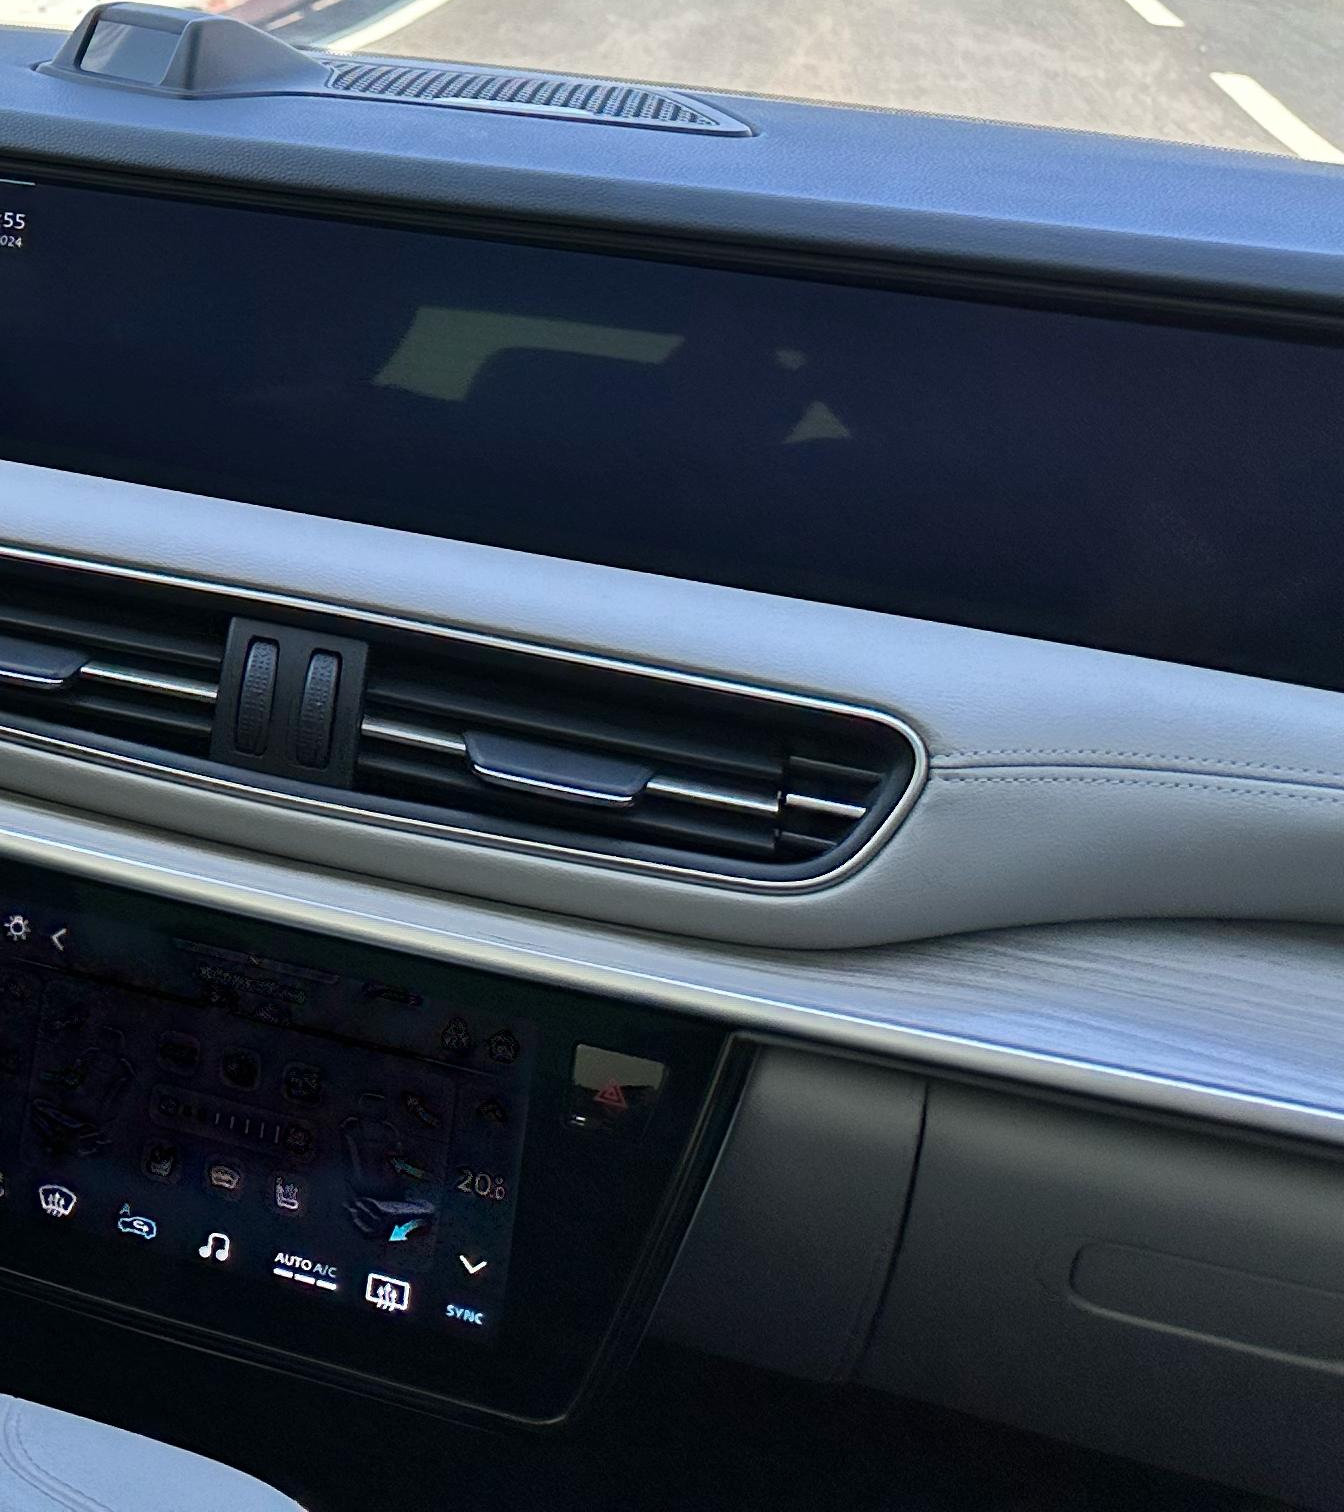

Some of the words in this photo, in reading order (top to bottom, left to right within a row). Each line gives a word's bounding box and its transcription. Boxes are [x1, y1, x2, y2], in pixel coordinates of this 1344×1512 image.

[274, 1252, 312, 1271] AUTO
[313, 1263, 337, 1278] A/C
[444, 1303, 484, 1325] SYNC
